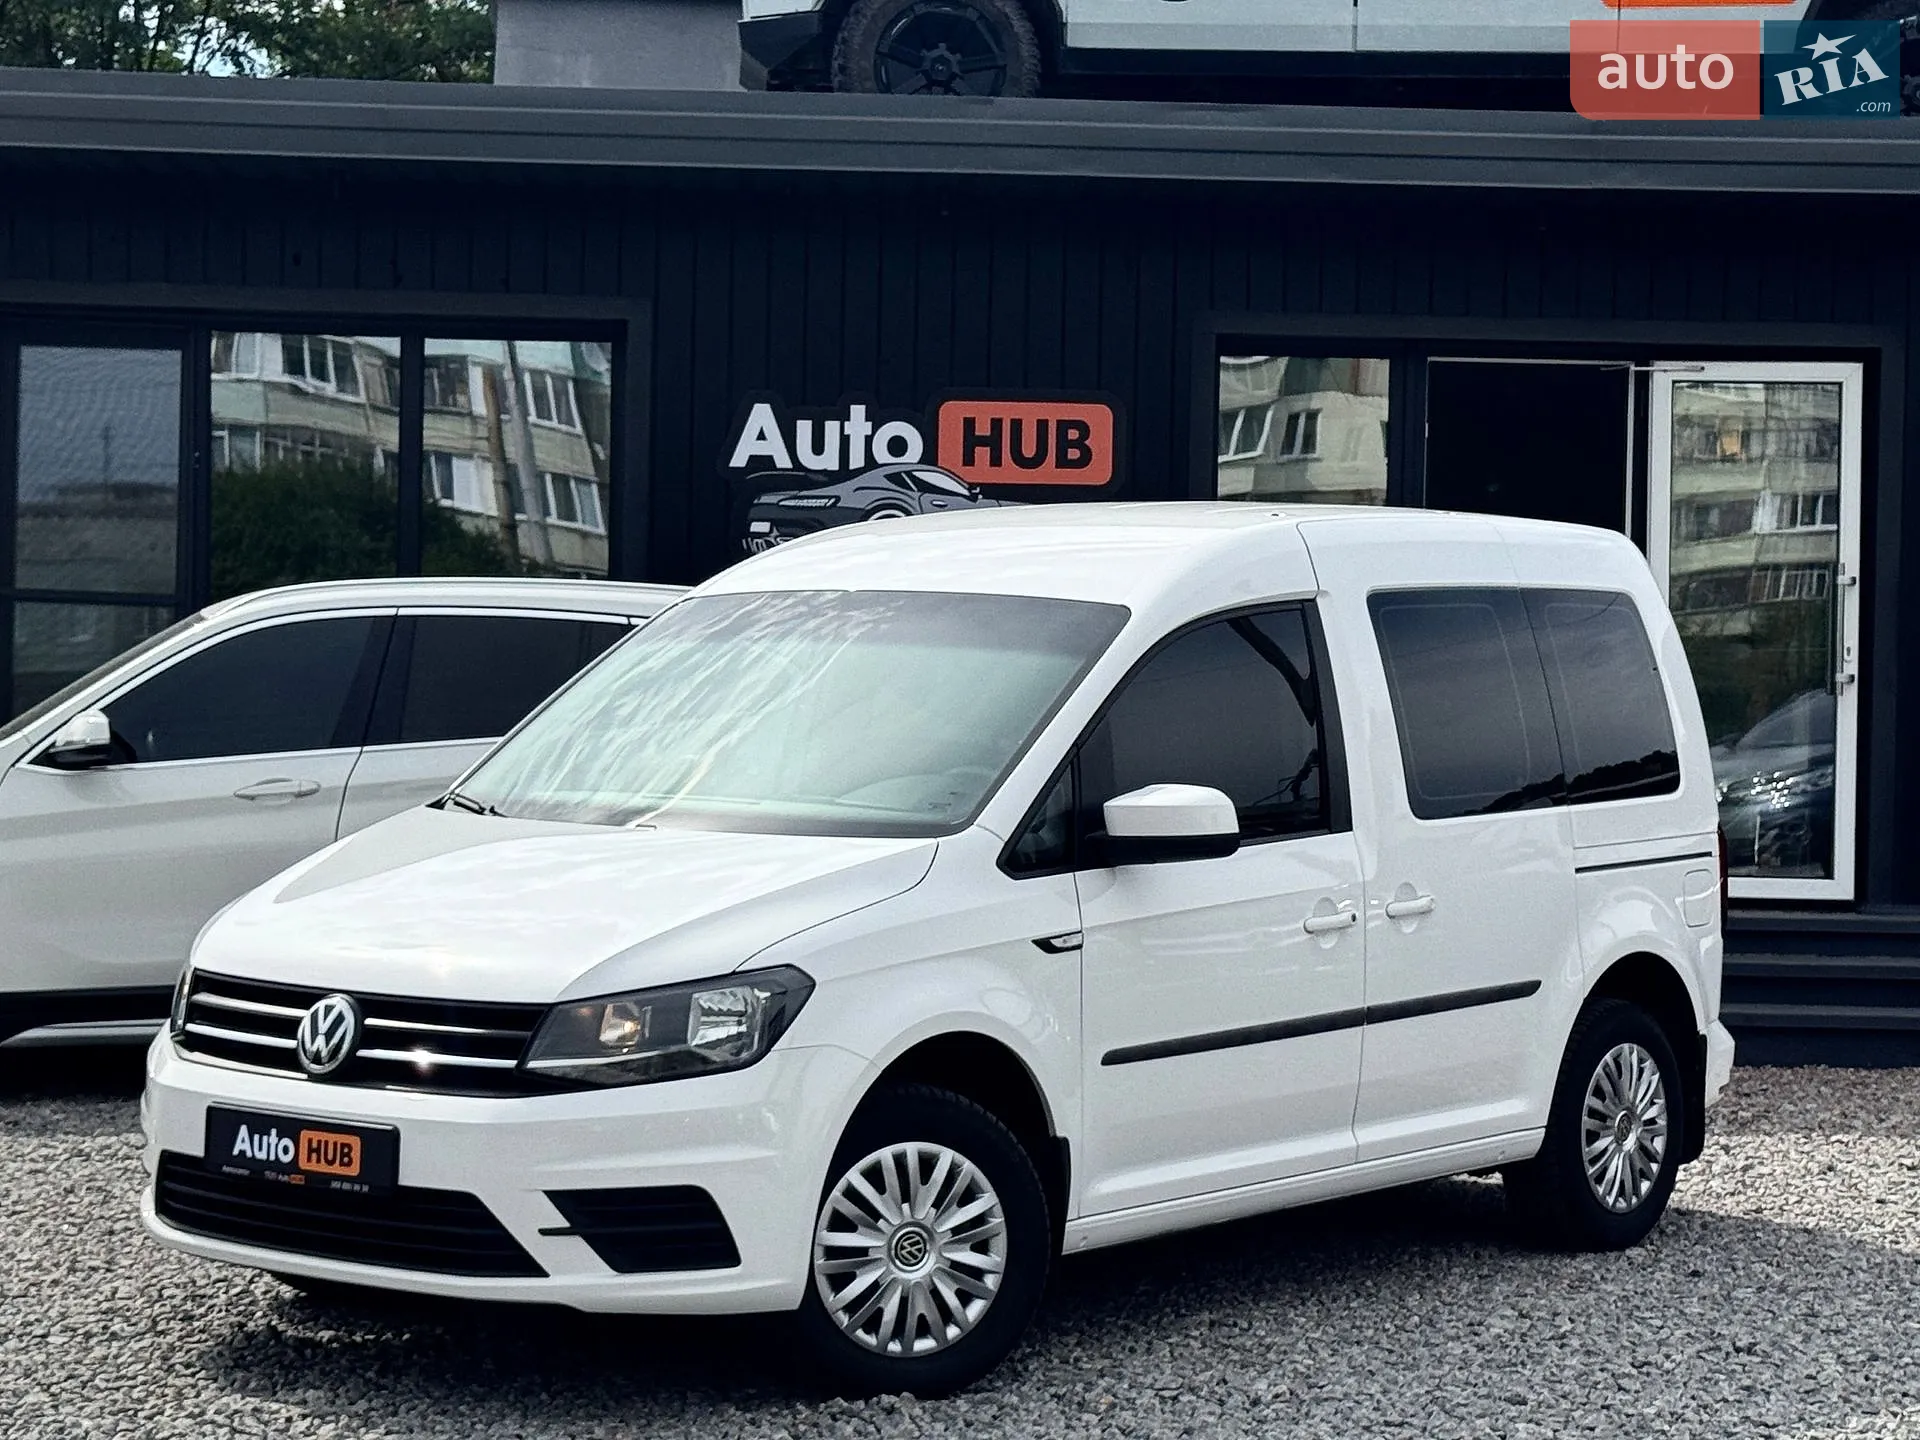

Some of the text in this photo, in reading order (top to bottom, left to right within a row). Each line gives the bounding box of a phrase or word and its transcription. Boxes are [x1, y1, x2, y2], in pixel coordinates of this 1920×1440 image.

[728, 403, 1093, 470] Auto HUB
[232, 1123, 354, 1167] Auto HUB
